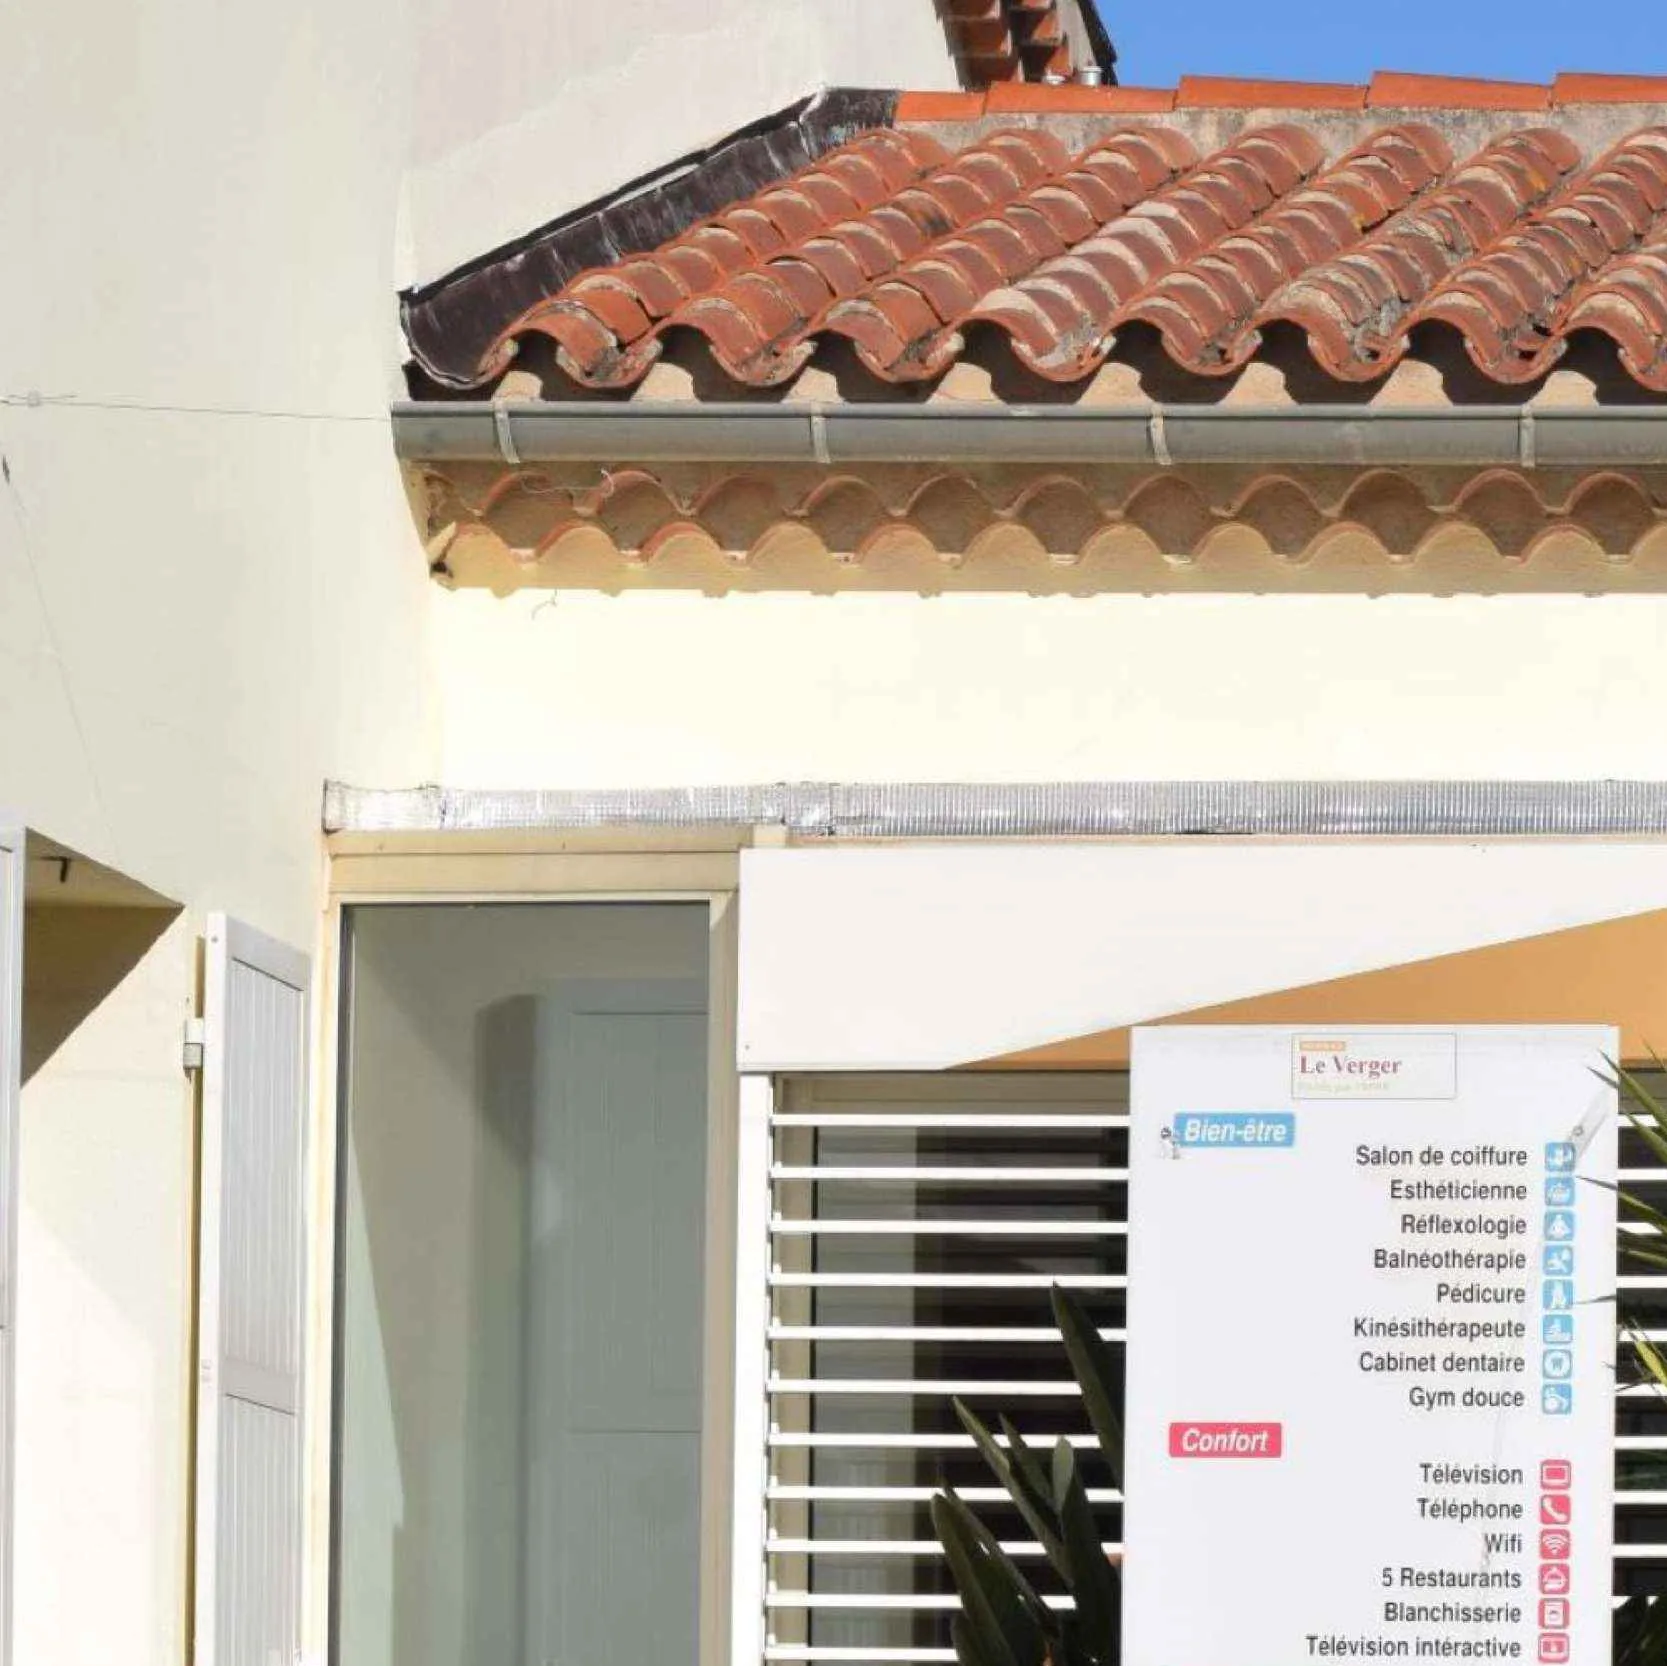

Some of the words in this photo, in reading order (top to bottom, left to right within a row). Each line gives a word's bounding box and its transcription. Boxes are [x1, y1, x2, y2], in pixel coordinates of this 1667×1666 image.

[1299, 1055, 1326, 1074] Le
[1332, 1055, 1402, 1079] Verger
[1183, 1116, 1287, 1144] Bien-être
[1356, 1144, 1413, 1166] Salon
[1419, 1146, 1444, 1166] de
[1450, 1145, 1527, 1166] coiffure
[1390, 1179, 1527, 1200] Esthéticienne
[1401, 1213, 1527, 1240] Réflexologie
[1374, 1248, 1526, 1273] Balnéothérapie
[1437, 1282, 1526, 1304] Pédicure
[1354, 1317, 1526, 1342] Kinésithérapeute
[1359, 1351, 1436, 1372] Cabinet
[1442, 1352, 1525, 1373] dentaire
[1409, 1386, 1456, 1411] Gym
[1462, 1387, 1525, 1407] douce
[1183, 1429, 1268, 1451] Confort
[1419, 1463, 1522, 1485] Télévision
[1417, 1497, 1523, 1523] Téléphone
[1484, 1533, 1522, 1553] Wifi
[1382, 1567, 1393, 1587] 5
[1400, 1567, 1522, 1589] Restaurants
[1384, 1601, 1521, 1624] Blanchisserie
[1306, 1635, 1409, 1657] Télévision
[1415, 1637, 1521, 1658] intéractive
